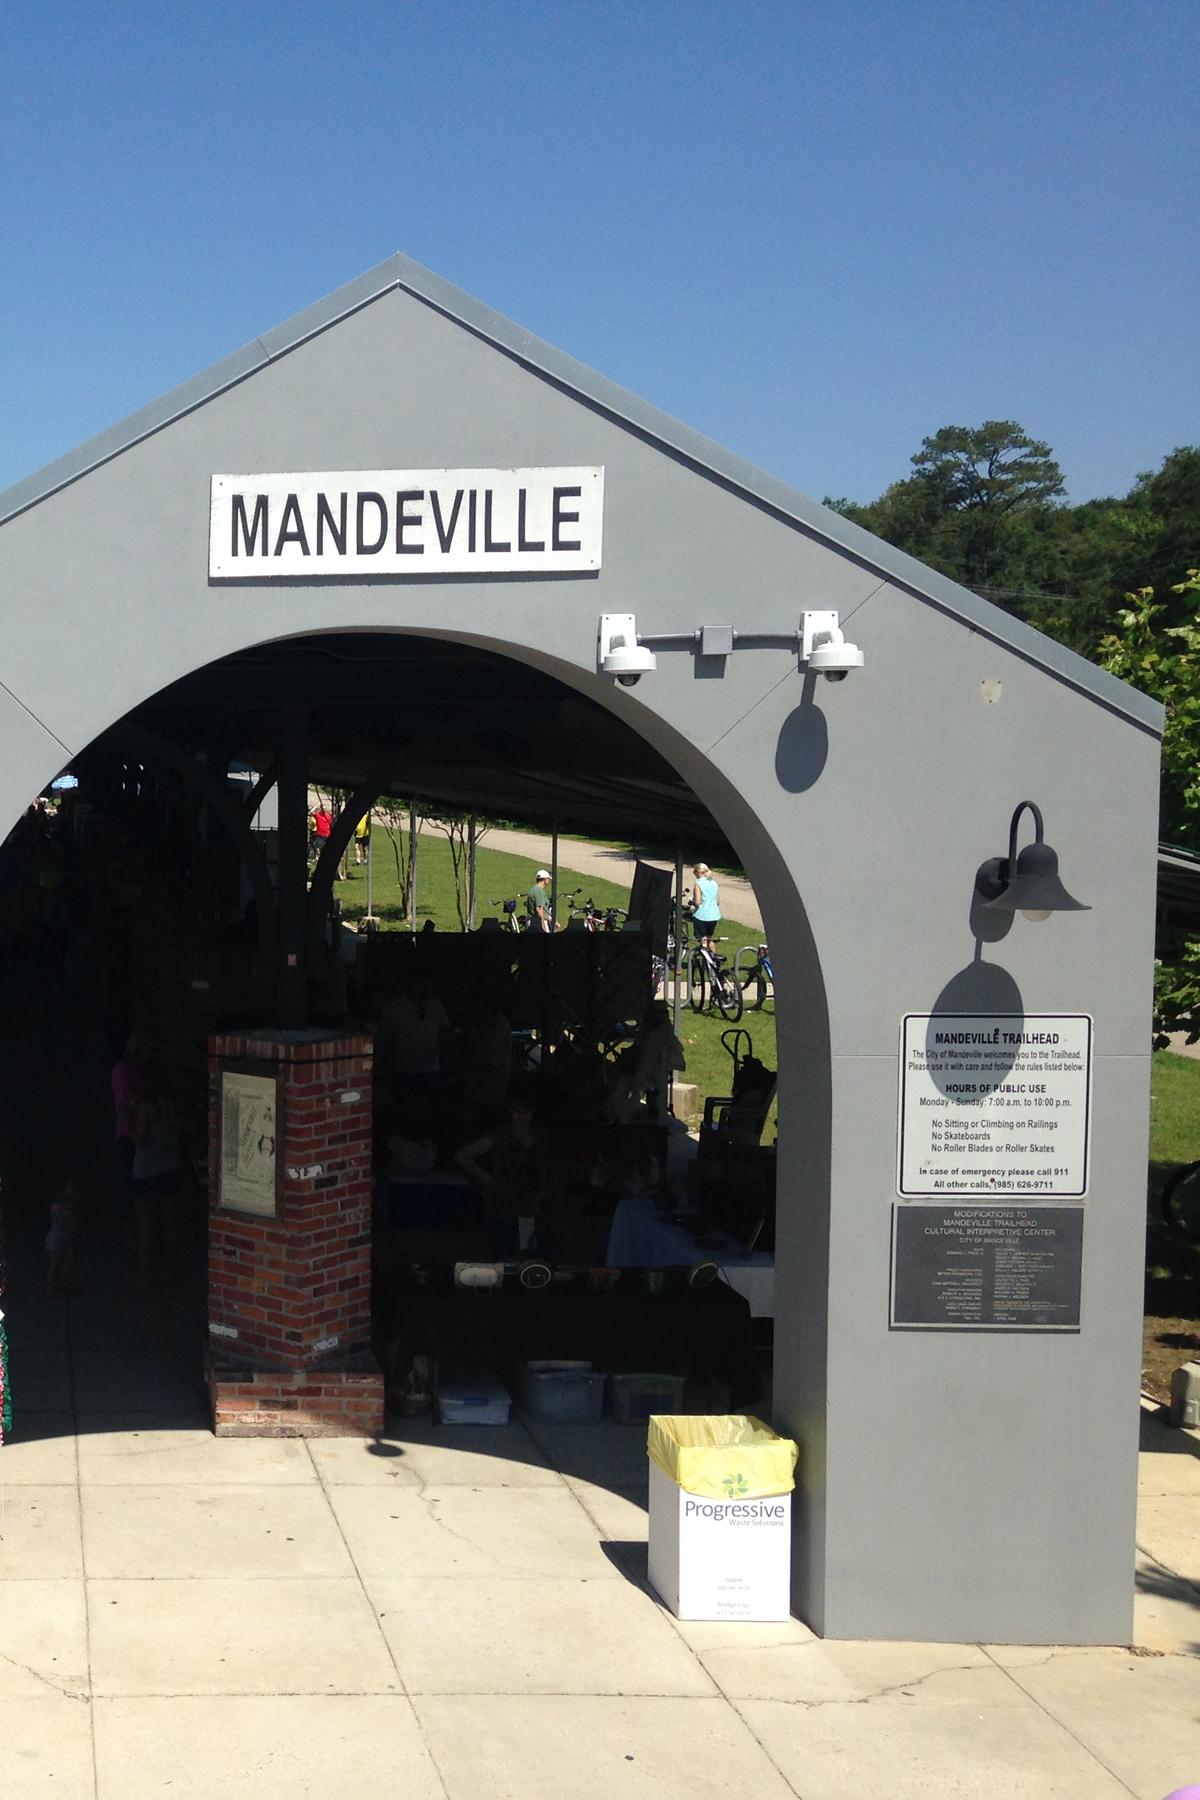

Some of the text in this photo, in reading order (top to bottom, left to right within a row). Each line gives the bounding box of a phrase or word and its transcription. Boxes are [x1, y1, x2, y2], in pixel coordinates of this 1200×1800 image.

[231, 486, 582, 557] MANDEVILLE
[935, 1032, 1060, 1044] MANDEVILLE TRAILHEAD
[912, 1049, 1082, 1061] The City of Mandeville welcomes you to the Trailhead.
[908, 1062, 1085, 1071] Please use it with care and follow the rules listed below:
[946, 1084, 1047, 1093] HOURS OF PUBLIC USE
[920, 1097, 949, 1107] Monday
[956, 1097, 987, 1108] Sunday:
[989, 1097, 1004, 1106] 7:00
[1024, 1097, 1031, 1106] to
[1034, 1097, 1054, 1106] 10:00
[1055, 1100, 1072, 1108] p.m.
[932, 1119, 1058, 1130] No Sitting or Climbing on Railings
[932, 1131, 991, 1140] No Skateboards
[931, 1143, 942, 1152] No
[943, 1143, 966, 1152] Roller
[968, 1143, 993, 1152] Blades
[1005, 1143, 1028, 1152] Roller
[1029, 1143, 1055, 1152] Skates
[961, 1168, 1006, 1177] emergency
[1008, 1168, 1035, 1177] please
[1053, 1168, 1069, 1176] 911
[933, 1180, 1054, 1190] All other calls, (985) 626-9711
[685, 1500, 785, 1521] Progressive
